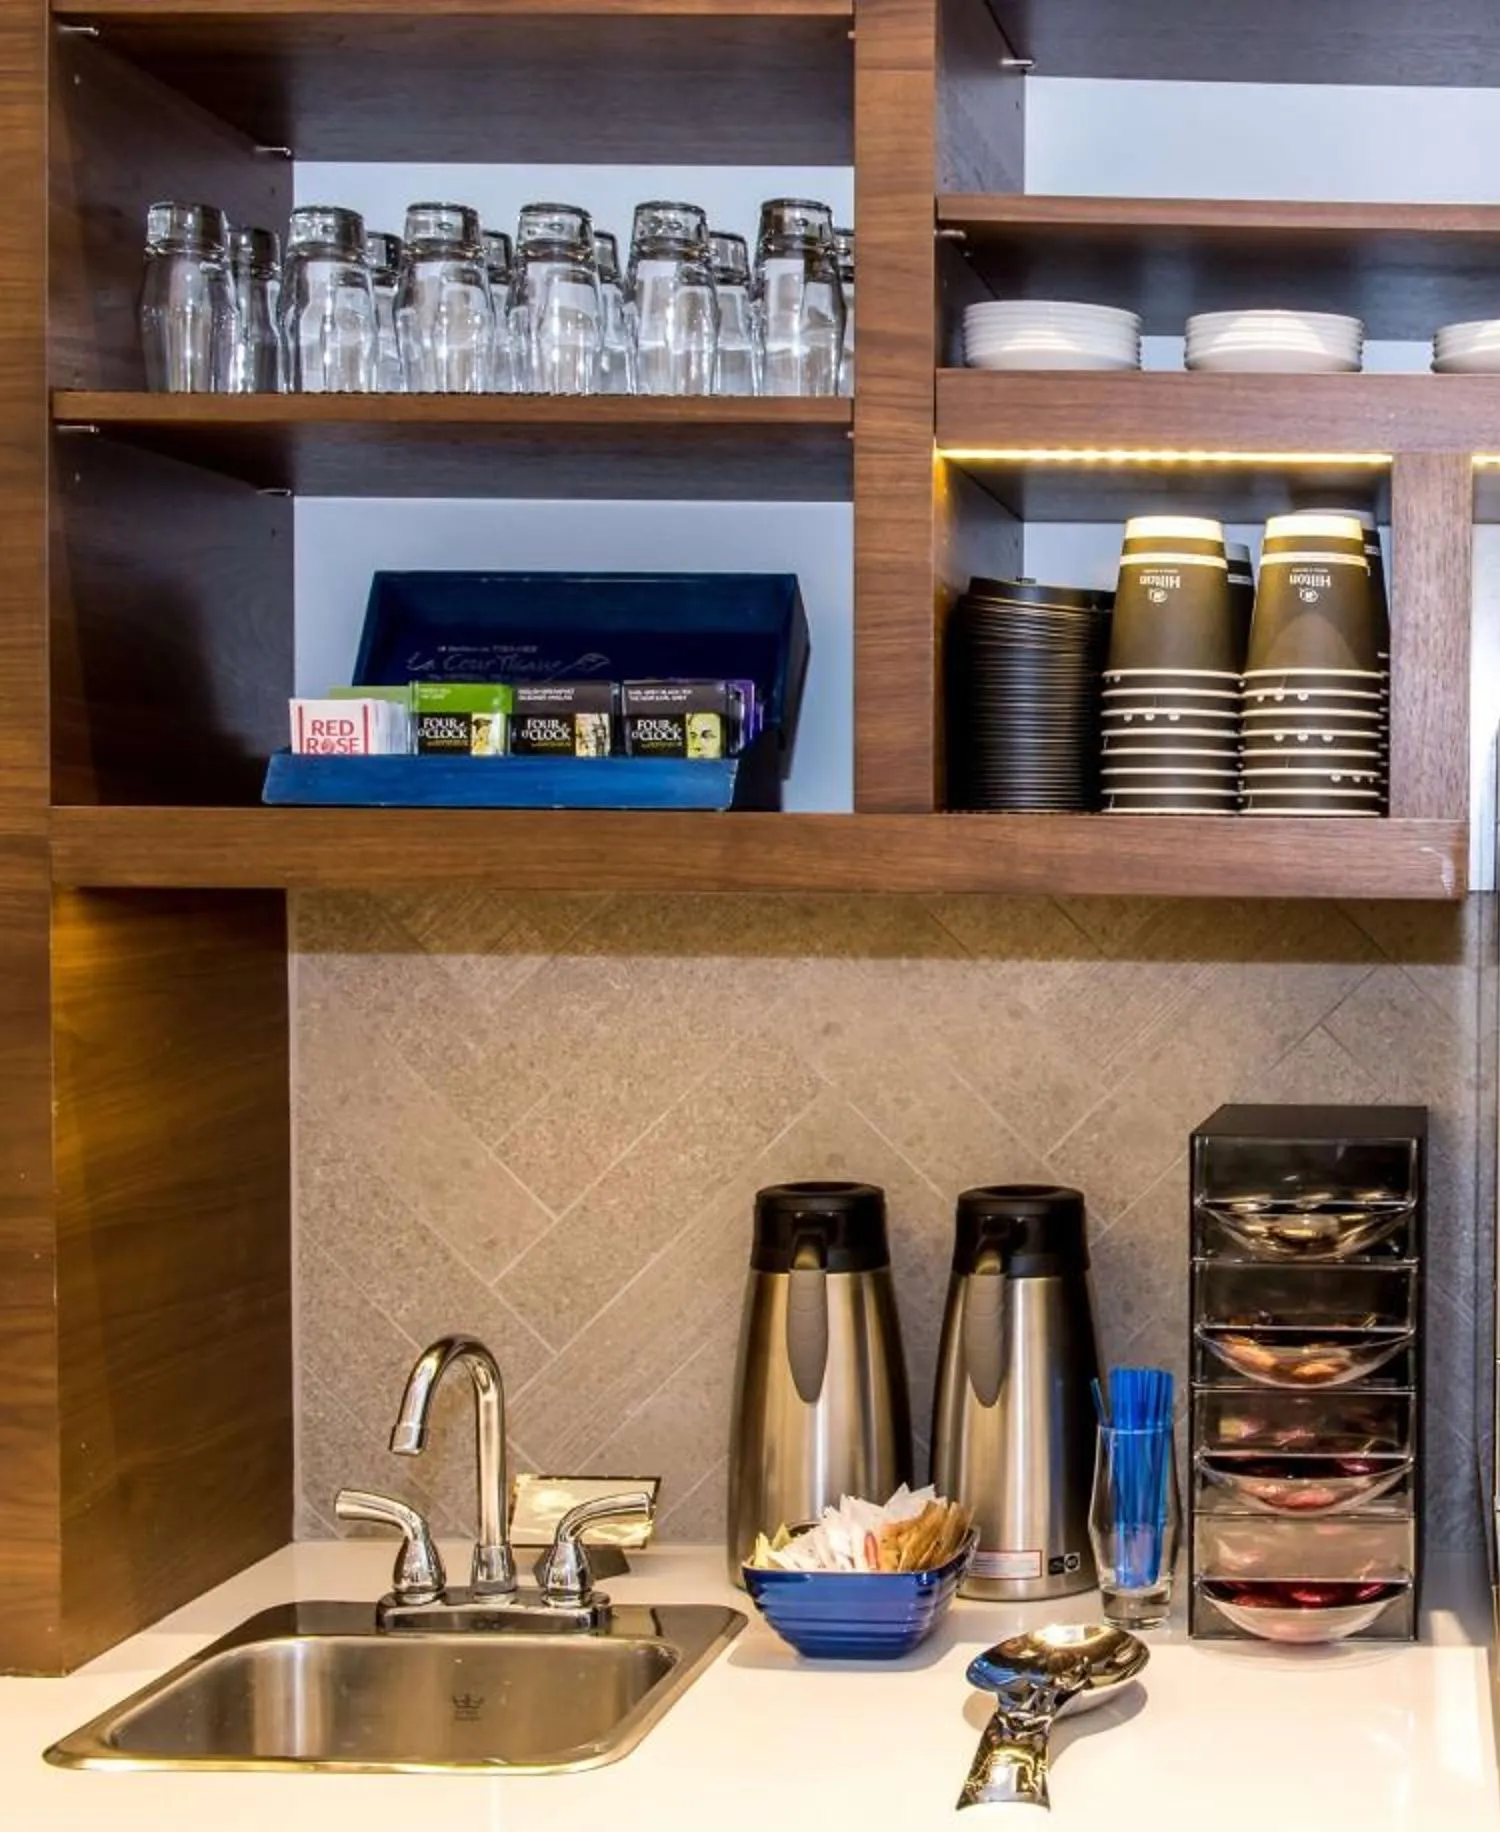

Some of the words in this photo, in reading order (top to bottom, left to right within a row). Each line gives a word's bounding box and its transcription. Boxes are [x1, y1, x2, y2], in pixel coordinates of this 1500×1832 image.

[1139, 575, 1181, 588] Hilton
[1289, 574, 1331, 588] Hilton
[311, 719, 355, 737] RED
[424, 718, 458, 730] FOUR
[527, 719, 560, 730] FOUR
[637, 719, 670, 731] FOUR
[306, 737, 360, 754] ROSE
